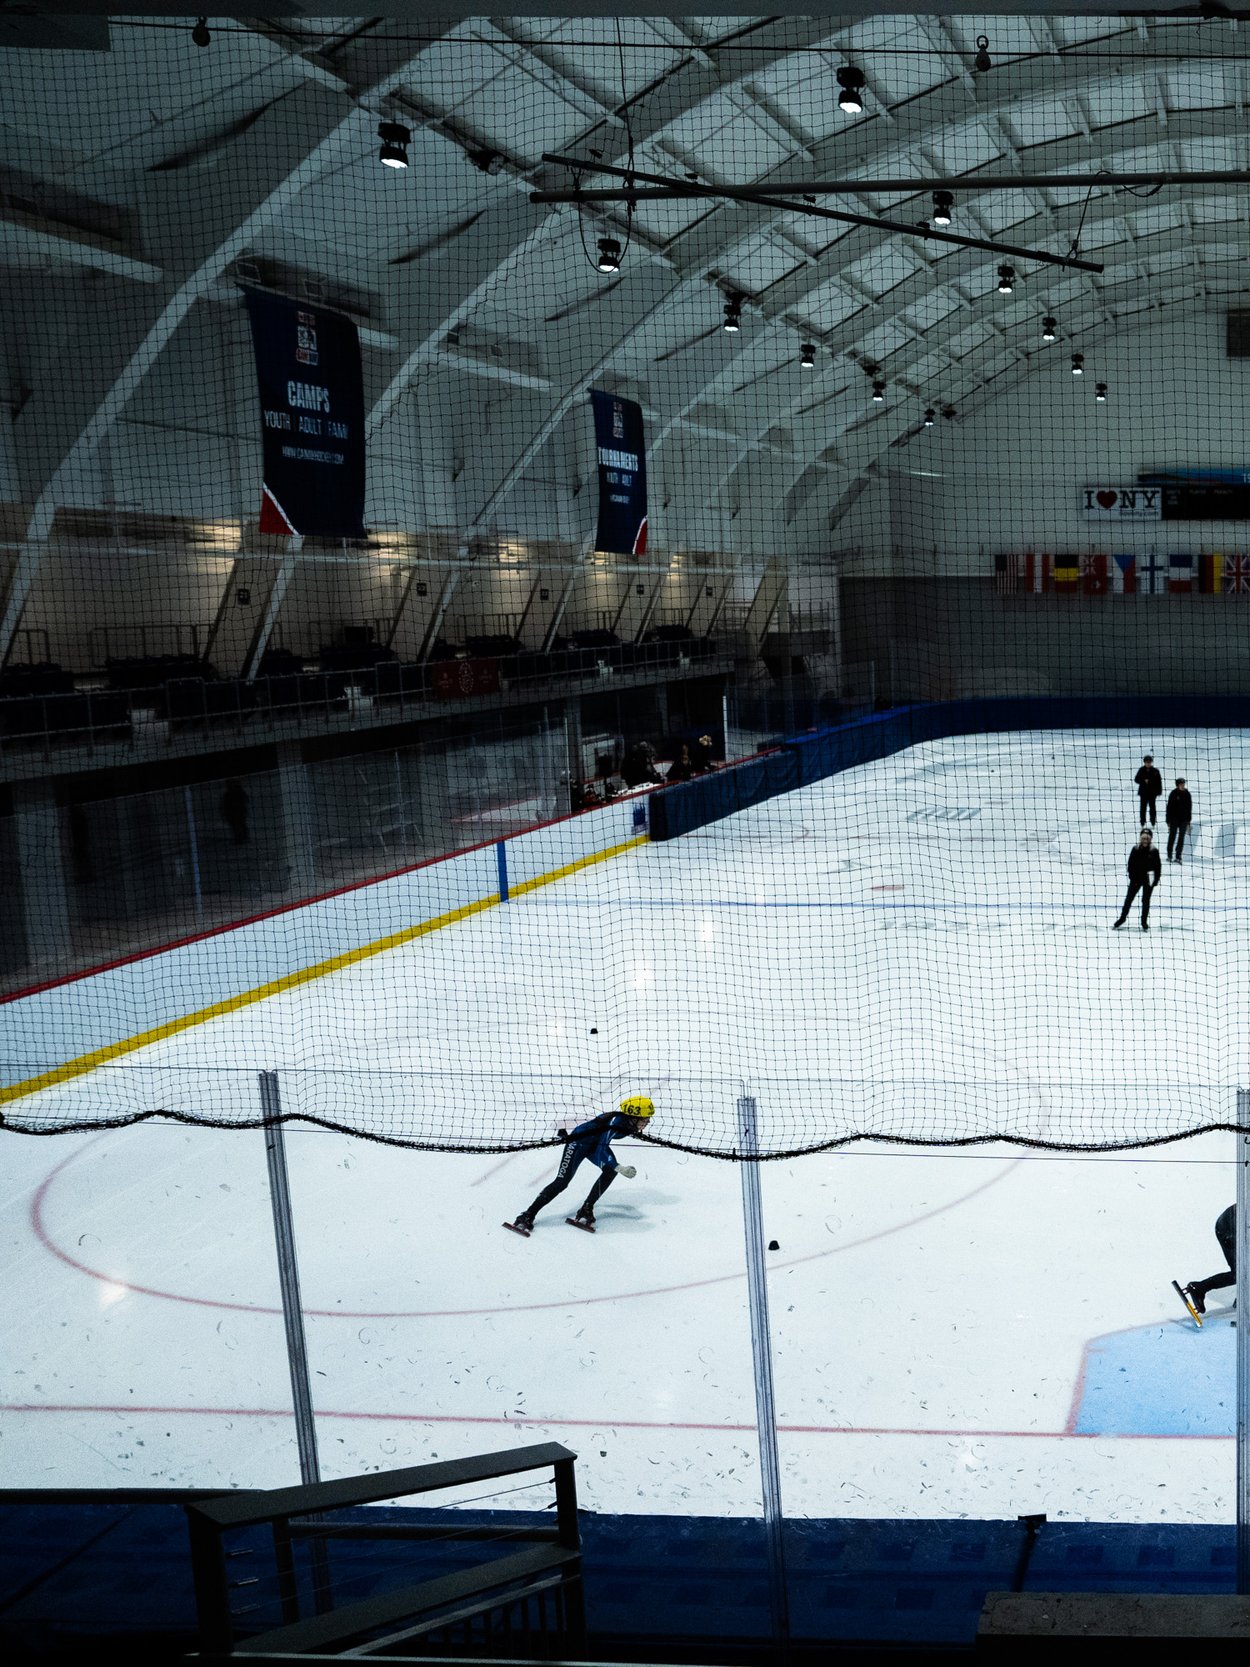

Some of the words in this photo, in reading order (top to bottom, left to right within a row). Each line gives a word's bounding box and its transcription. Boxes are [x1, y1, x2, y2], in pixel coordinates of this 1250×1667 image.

[287, 380, 330, 413] CAMPS
[264, 410, 291, 431] YOUTH
[1084, 490, 1095, 509] I
[1119, 490, 1160, 509] NY
[623, 1103, 641, 1115] 163
